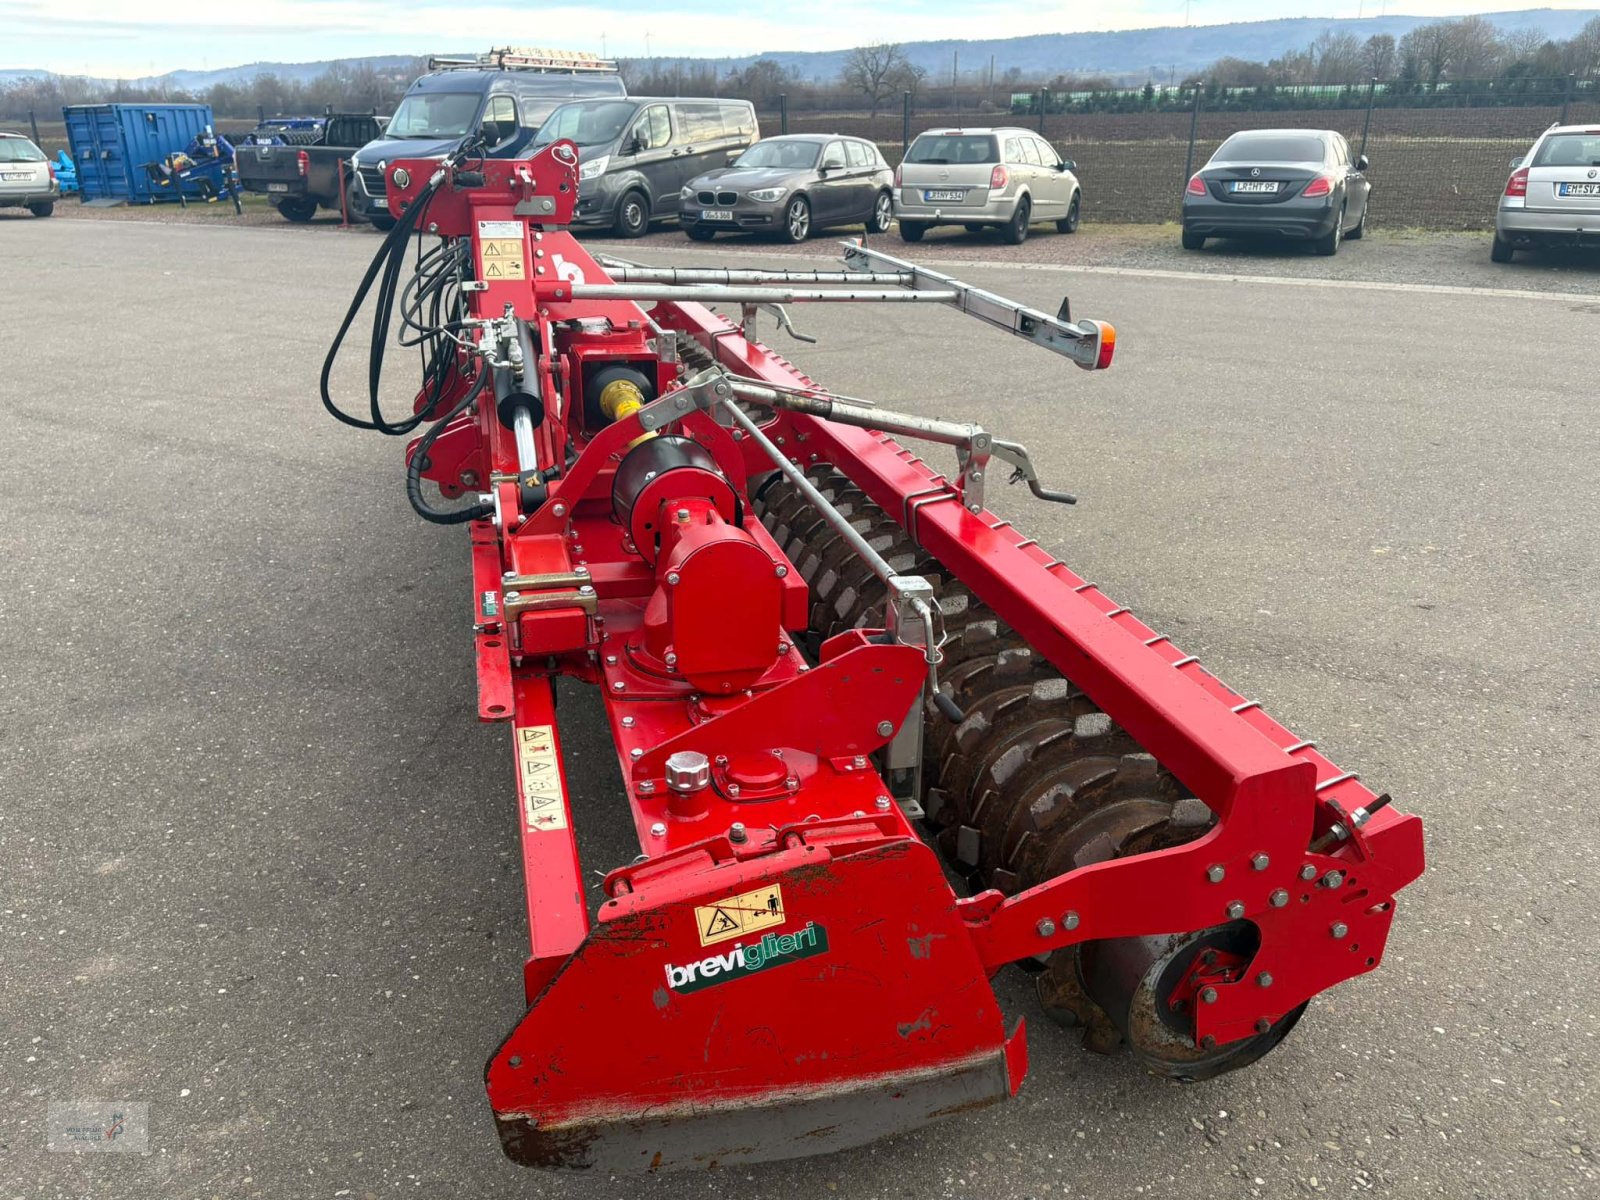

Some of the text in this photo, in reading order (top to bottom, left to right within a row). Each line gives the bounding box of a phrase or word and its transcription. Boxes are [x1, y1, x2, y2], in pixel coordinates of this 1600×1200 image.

[1566, 184, 1578, 194] EM
[1583, 184, 1595, 194] SV
[664, 921, 818, 989] breviglieri
